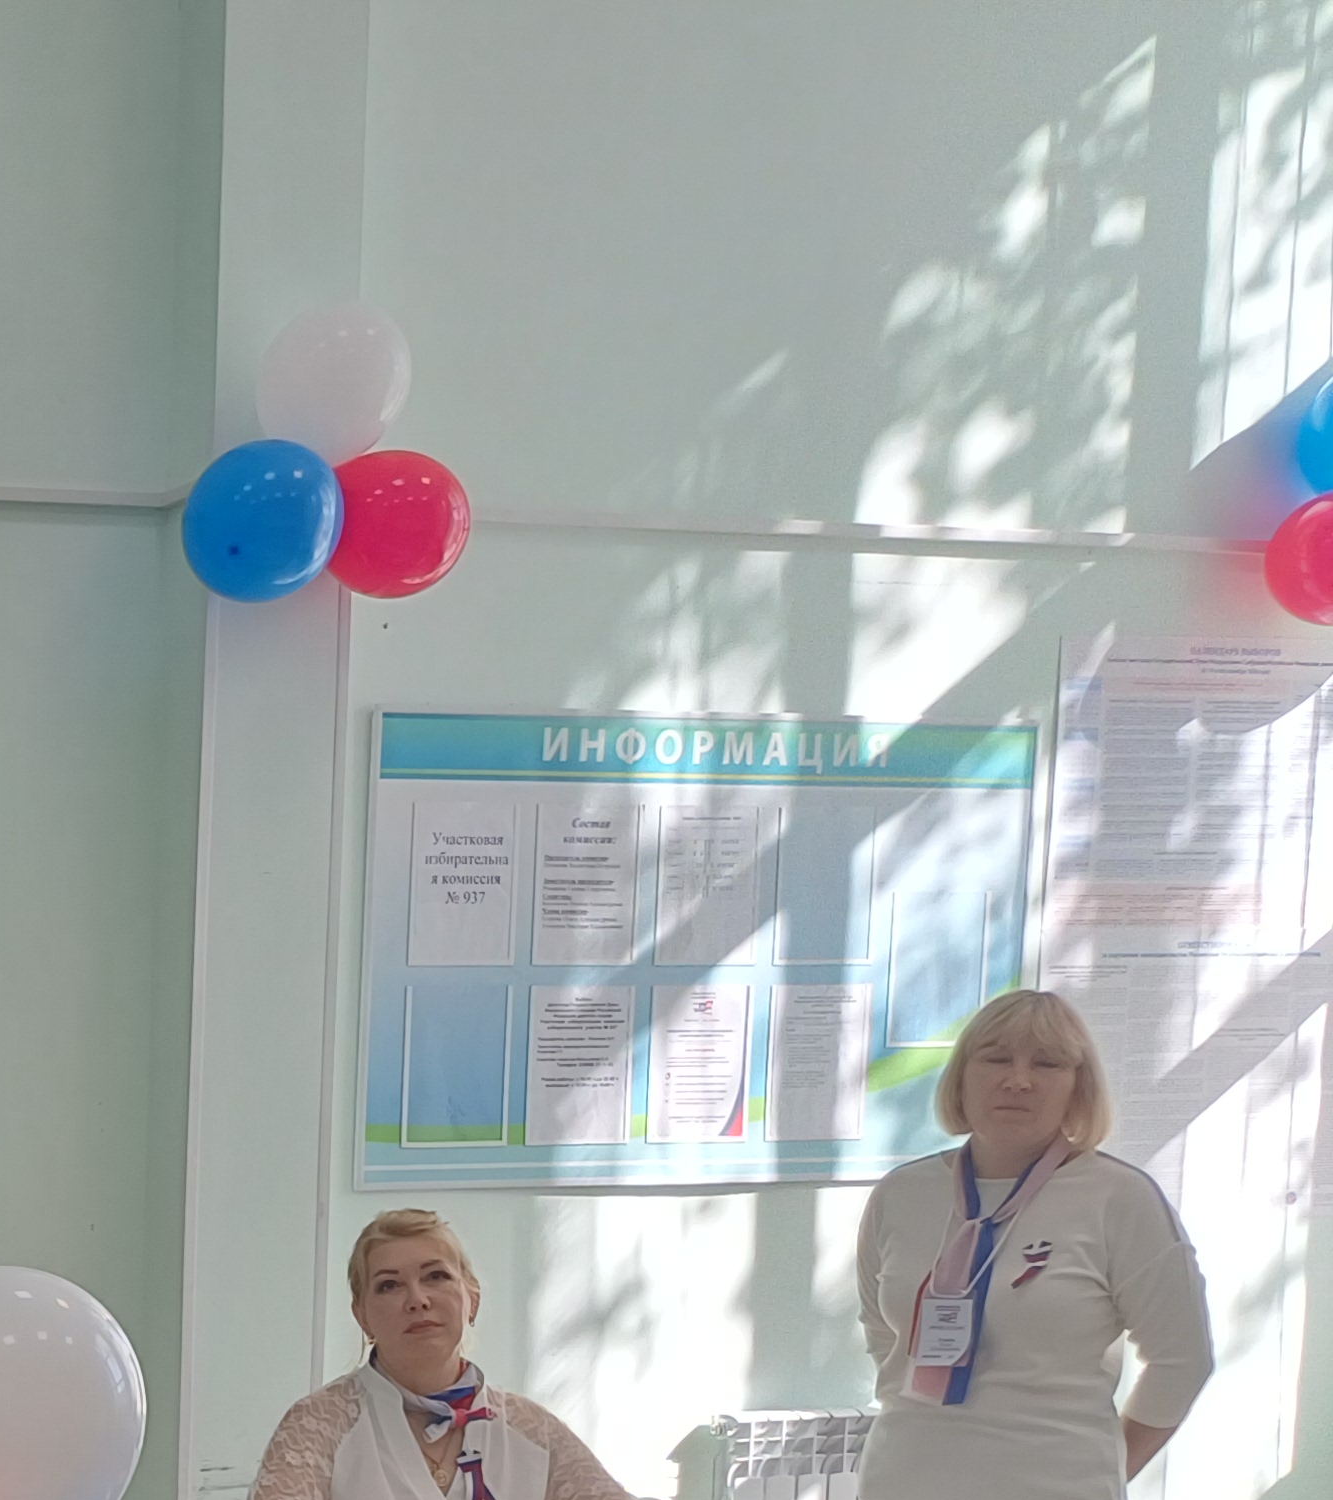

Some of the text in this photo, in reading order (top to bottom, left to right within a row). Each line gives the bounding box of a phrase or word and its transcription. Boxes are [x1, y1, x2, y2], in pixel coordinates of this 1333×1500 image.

[542, 726, 890, 774] ИНФОРМАЦИЯ
[433, 832, 503, 845] Участковая
[425, 852, 508, 868] избирательна
[431, 875, 501, 885] я комиссия
[445, 891, 485, 904] № 937
